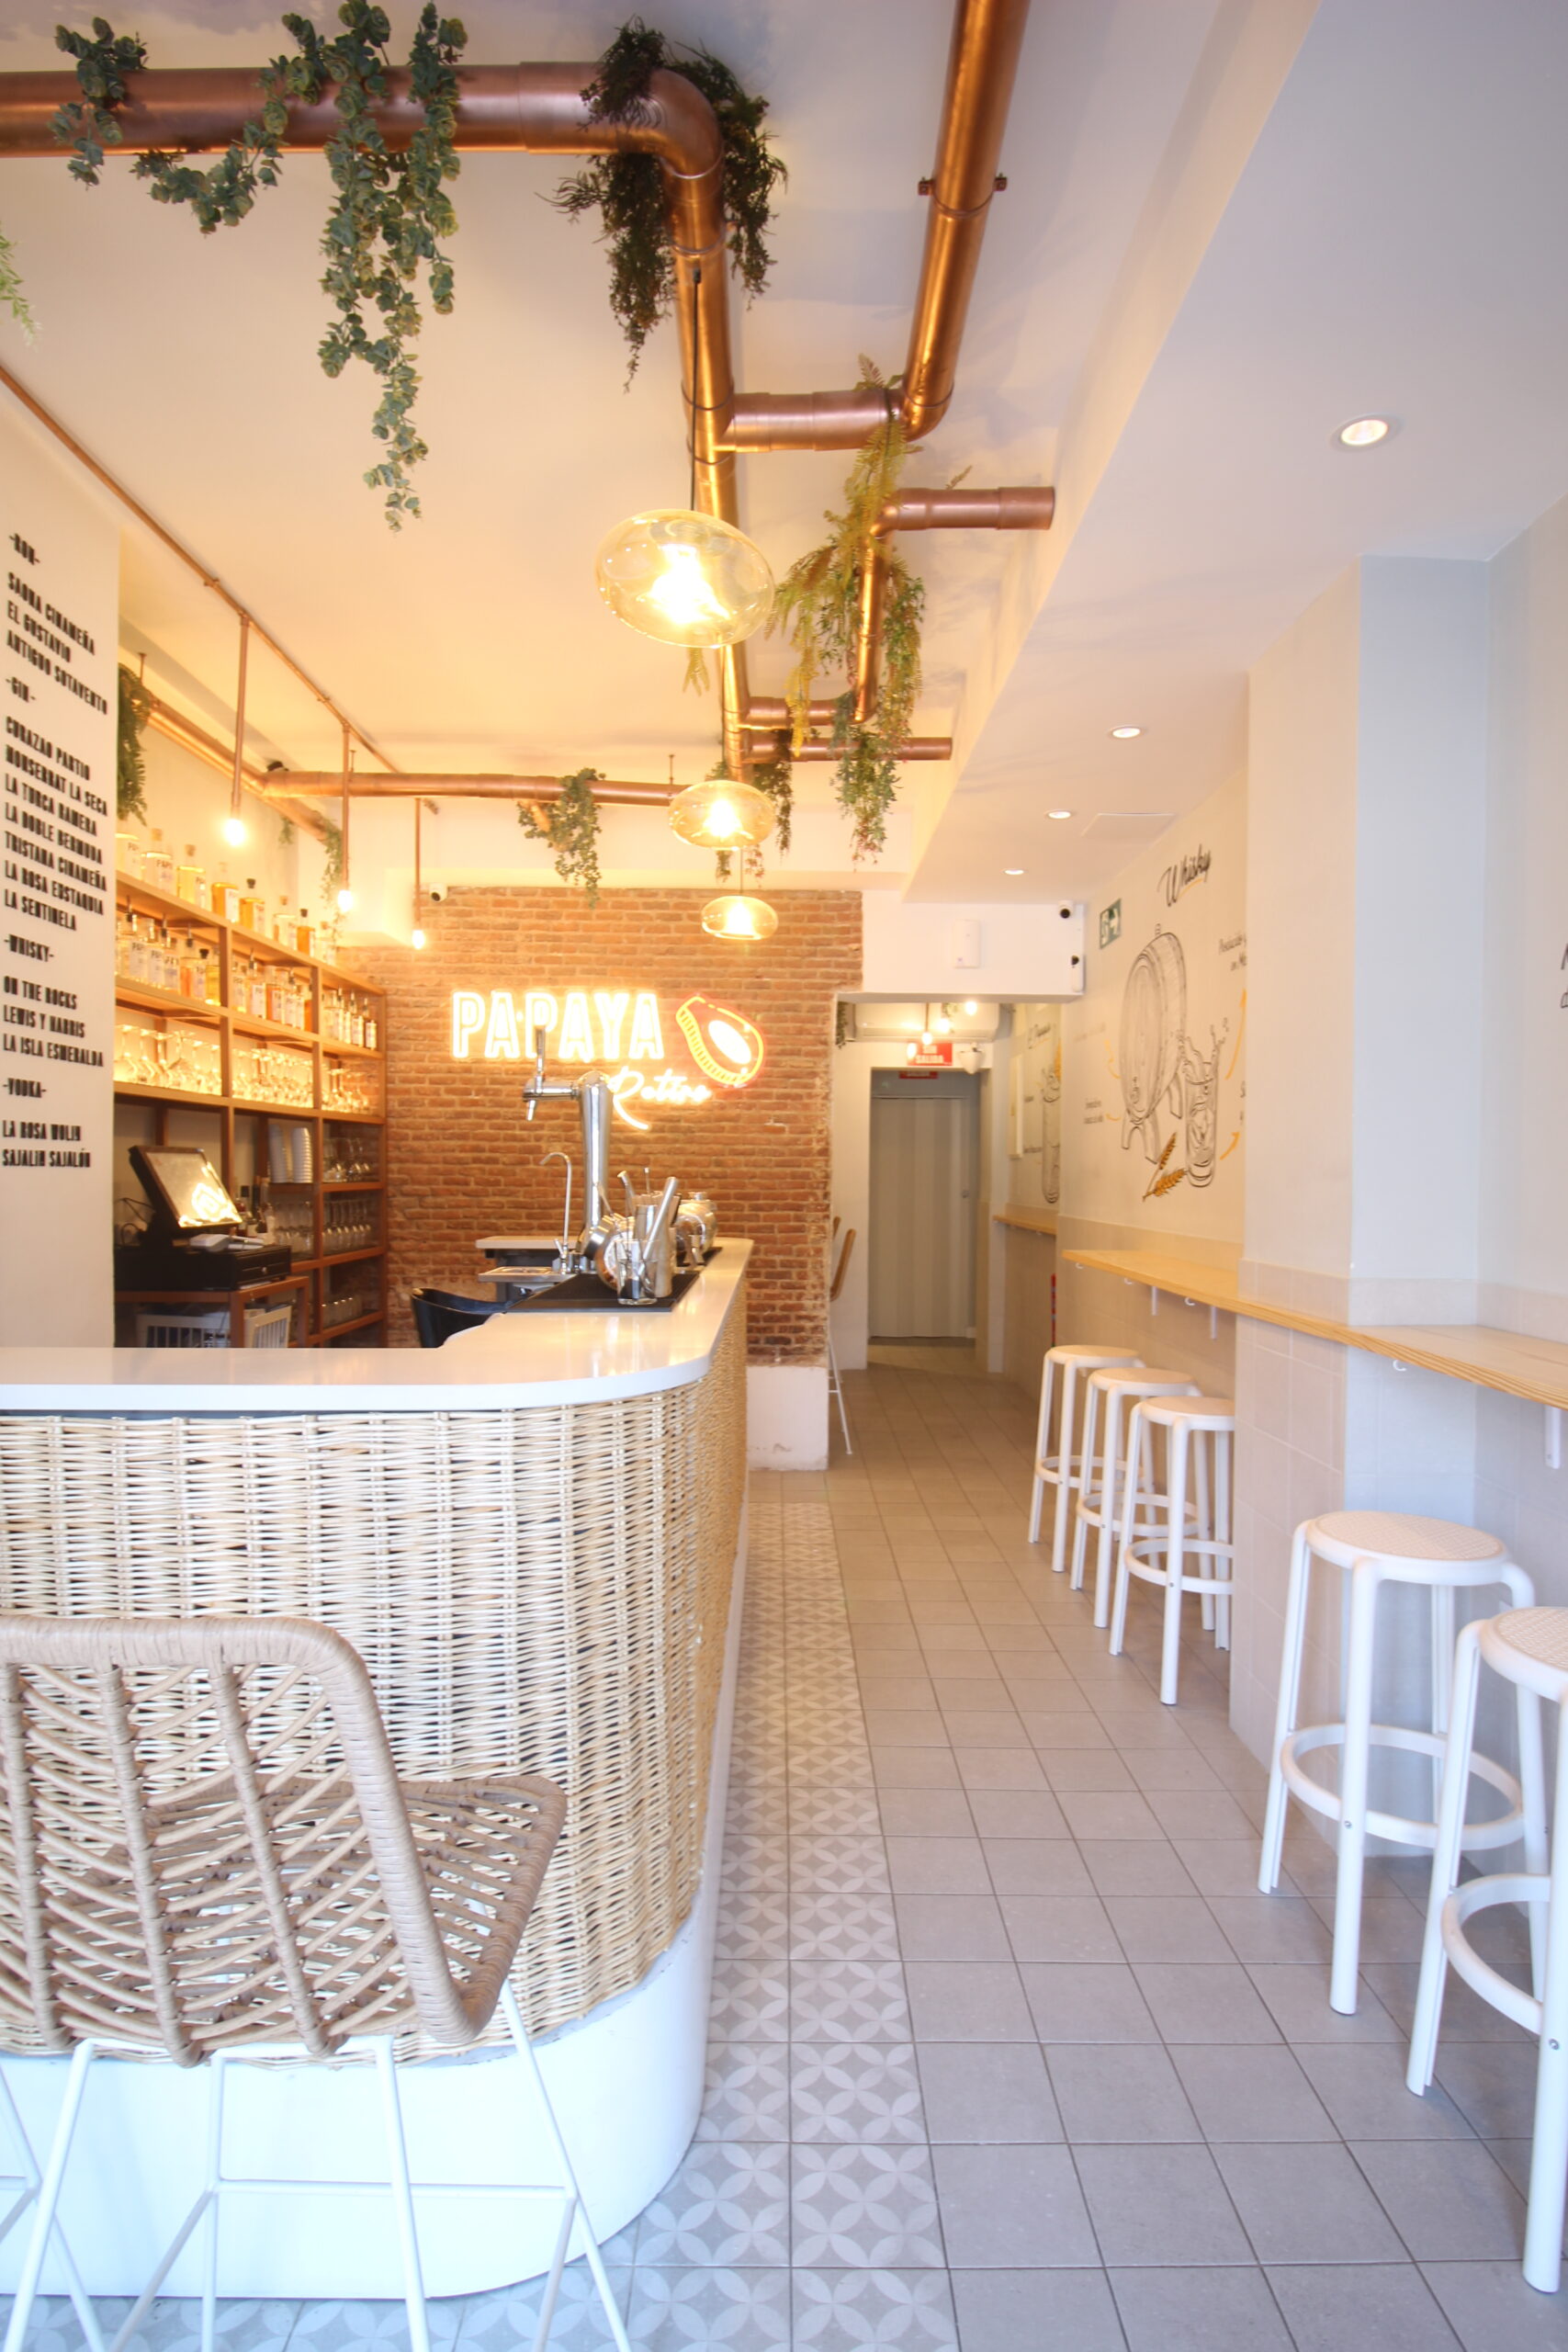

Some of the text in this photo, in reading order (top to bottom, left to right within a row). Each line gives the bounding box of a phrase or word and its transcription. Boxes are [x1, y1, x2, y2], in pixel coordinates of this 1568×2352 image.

[8, 600, 20, 625] EL
[7, 630, 51, 675] ANTIGUO
[6, 773, 18, 795] LA
[70, 782, 81, 802] LA
[85, 791, 107, 816] SECA
[5, 831, 54, 869] TRISTANA
[6, 802, 102, 865] LA DOBLE BERMUDA
[5, 860, 17, 881] LA
[22, 867, 48, 894] ROSA
[5, 888, 76, 931] LA SENTINELA
[4, 976, 77, 1010] ON THE ROCKS
[4, 1005, 85, 1038] LEWIS Y HARRIS
[4, 1034, 104, 1067] LA ISLA ESMERALDA
[3, 1120, 81, 1141] LA ROSA WOLIN
[3, 1148, 91, 1168] SAJALIN SAJALÓN
